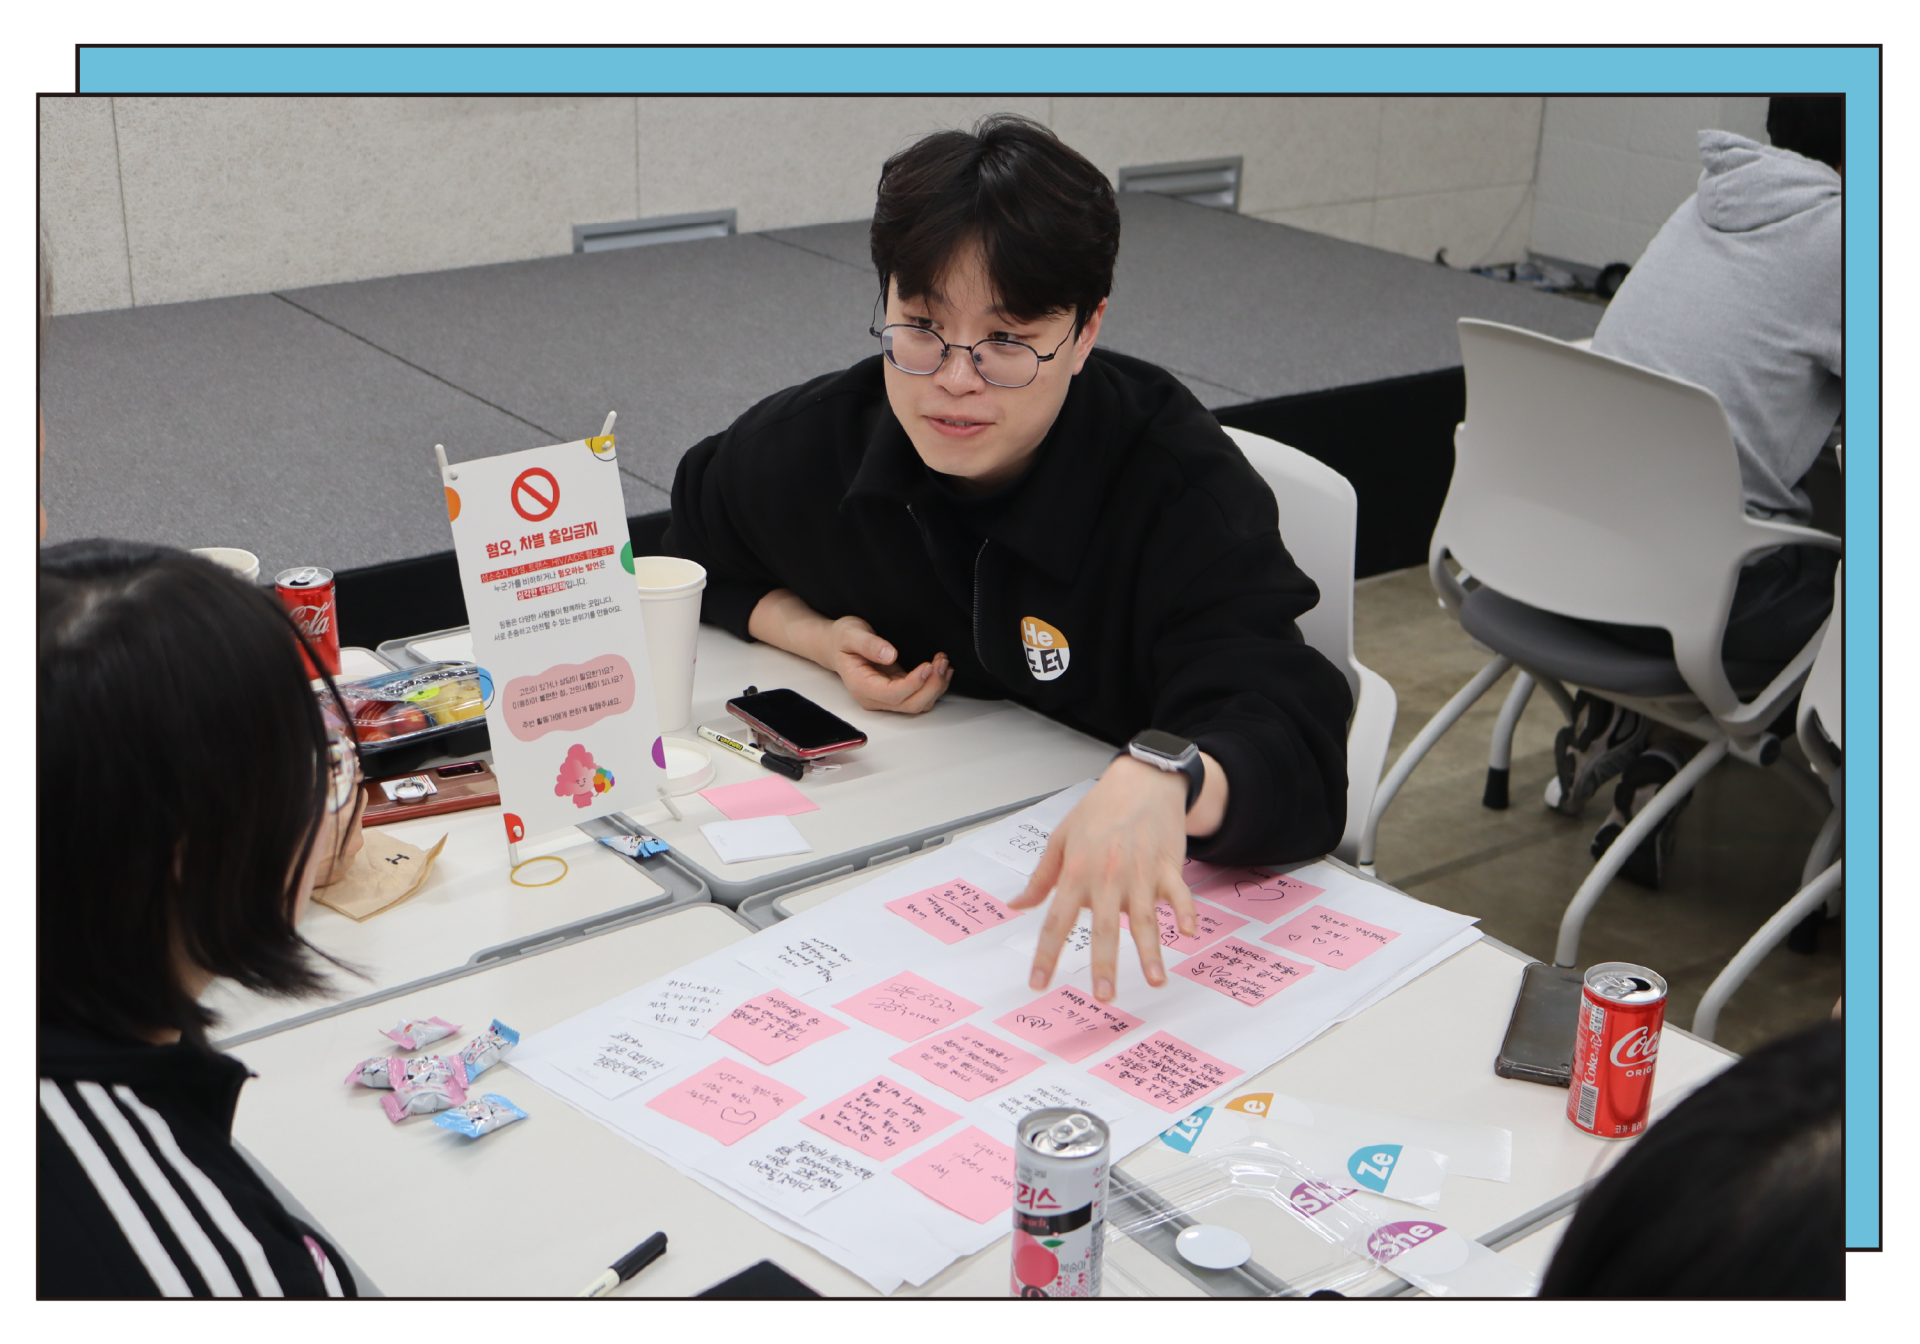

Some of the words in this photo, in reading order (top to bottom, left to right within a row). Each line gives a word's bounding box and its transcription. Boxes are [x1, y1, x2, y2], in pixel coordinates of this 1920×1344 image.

[485, 538, 517, 560] 혐오,
[518, 532, 545, 551] 차별
[547, 521, 598, 545] 출입금지
[551, 552, 584, 566] HIV/AIDS
[585, 549, 599, 559] 혐오
[600, 545, 614, 555] 금지
[493, 578, 521, 592] 누군가를
[522, 570, 556, 585] 비하하거나
[557, 564, 584, 578] 혐오하는
[585, 559, 605, 571] 발언은
[516, 587, 538, 600] 심각한
[539, 576, 587, 595] 인권침해입니다.
[493, 631, 506, 641] 서로
[506, 625, 531, 638] 존중하고
[531, 621, 550, 632] 안전할
[558, 616, 571, 625] 있는
[572, 610, 595, 622] 분위기를
[595, 604, 622, 617] 만들어요.
[518, 613, 537, 624] 다양한
[537, 607, 562, 620] 사람들이
[562, 601, 586, 614] 함께하는
[587, 595, 613, 608] 곳입니다.
[1022, 620, 1054, 647] He
[518, 684, 538, 696] 고민이
[538, 679, 558, 691] 있거나
[558, 674, 578, 686] 상담이
[579, 665, 614, 680] 필요한가요?
[539, 690, 558, 702] 불편한
[568, 679, 600, 694] 건의사항이
[600, 673, 624, 686] 있나요?
[522, 718, 535, 729] 주변
[536, 710, 568, 725] 활동가에게
[568, 704, 587, 716] 편하게
[588, 695, 621, 711] 말해주세요.
[1584, 1052, 1598, 1085] Coke
[1244, 1100, 1266, 1114] e
[1165, 1115, 1203, 1142] Ze
[1356, 1152, 1394, 1180] Ze
[1292, 1184, 1353, 1214] Sh
[1370, 1224, 1434, 1258] She
[1060, 1260, 1086, 1273] 복숭아
